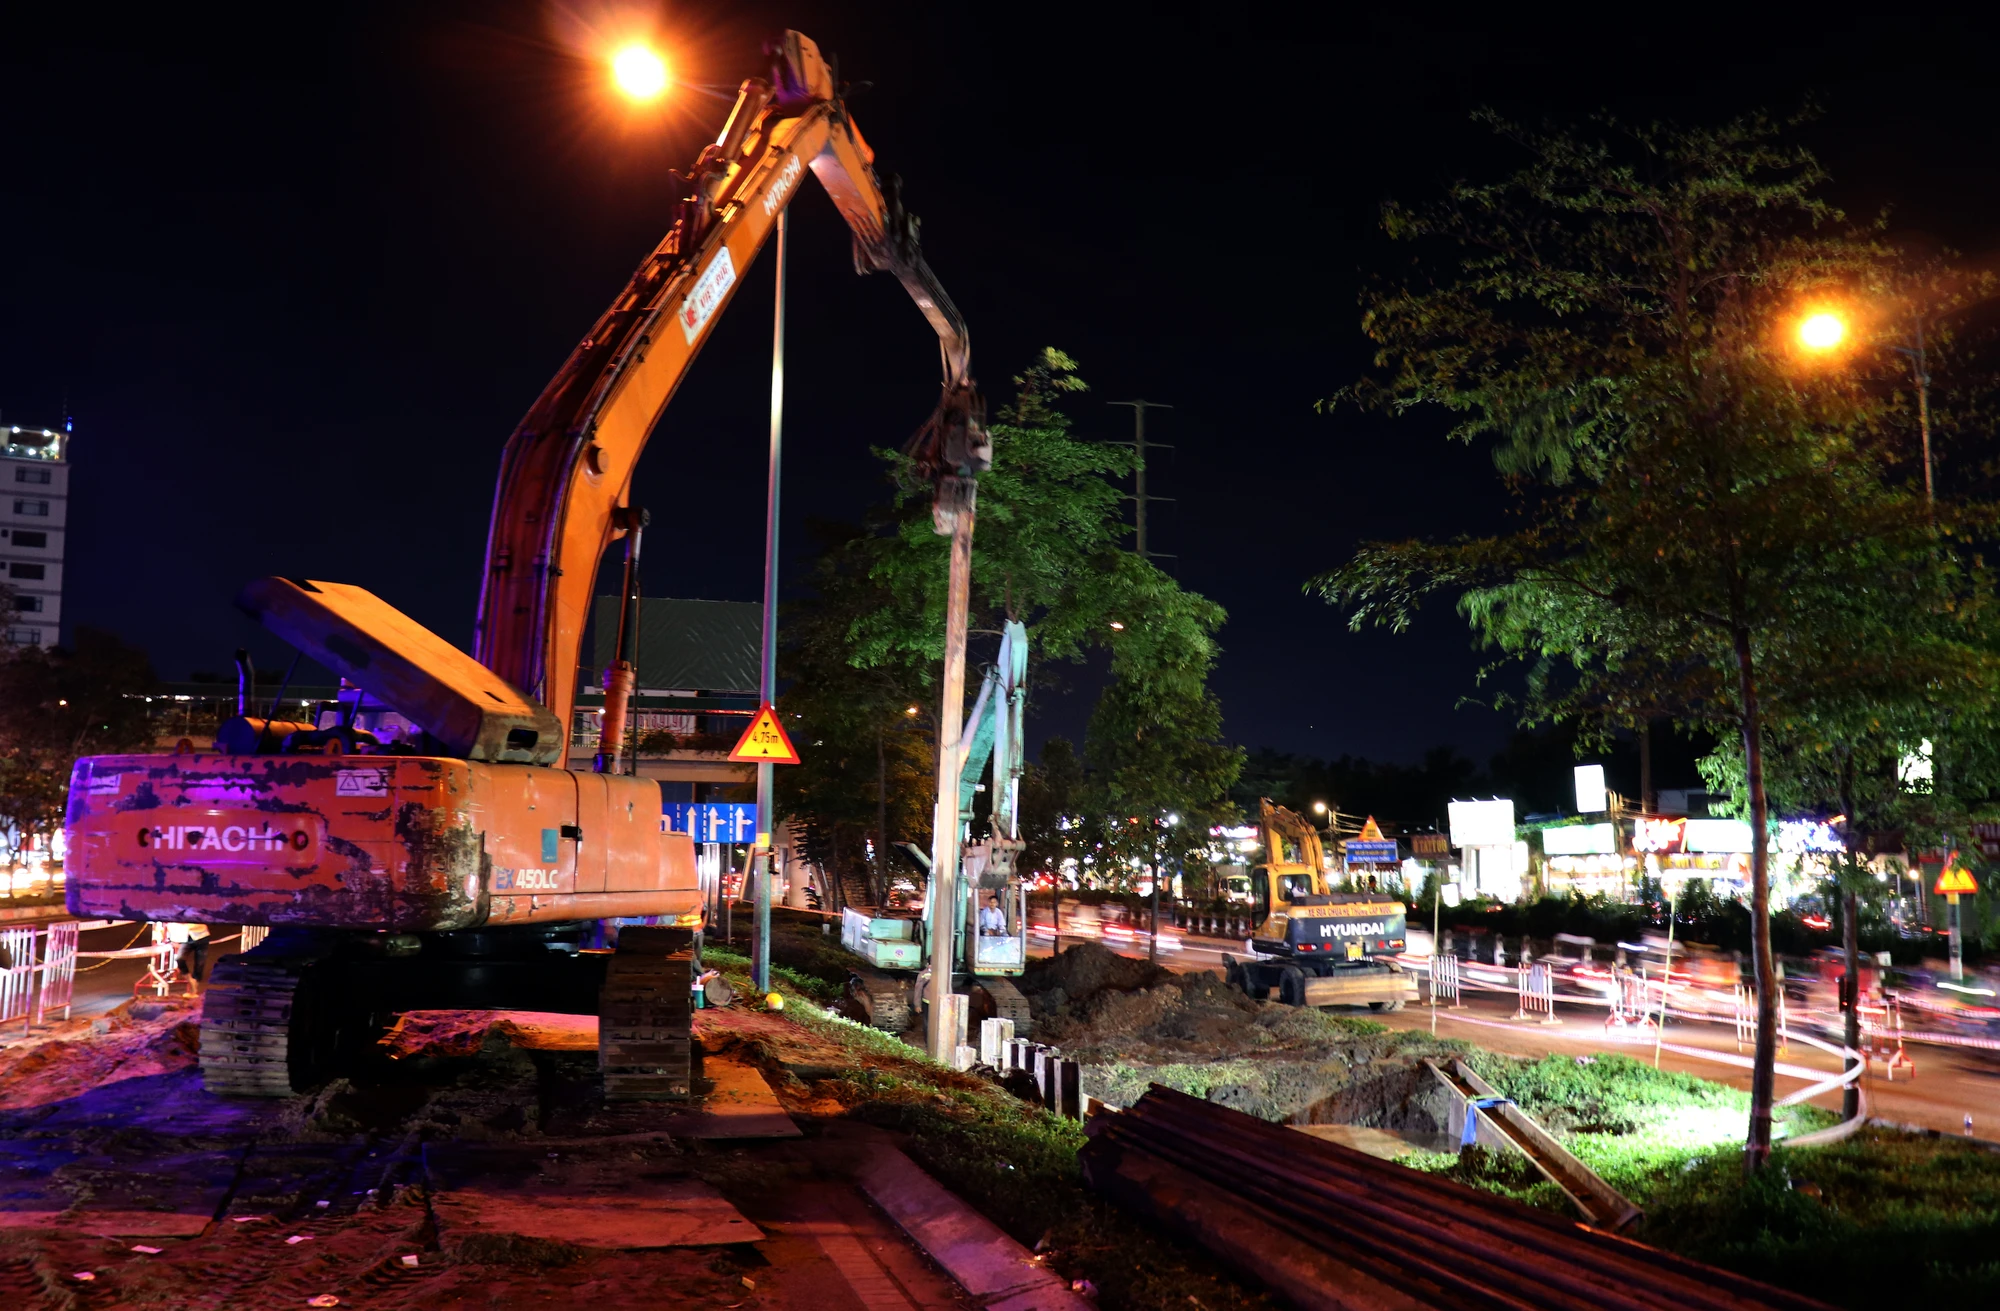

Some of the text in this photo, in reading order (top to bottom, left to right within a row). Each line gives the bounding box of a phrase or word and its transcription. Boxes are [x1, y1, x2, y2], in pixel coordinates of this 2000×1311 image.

[762, 155, 801, 216] HITACHI
[153, 826, 285, 851] HITACHI
[496, 868, 558, 889] EX 450LC
[1320, 922, 1385, 937] HYUNDAI
